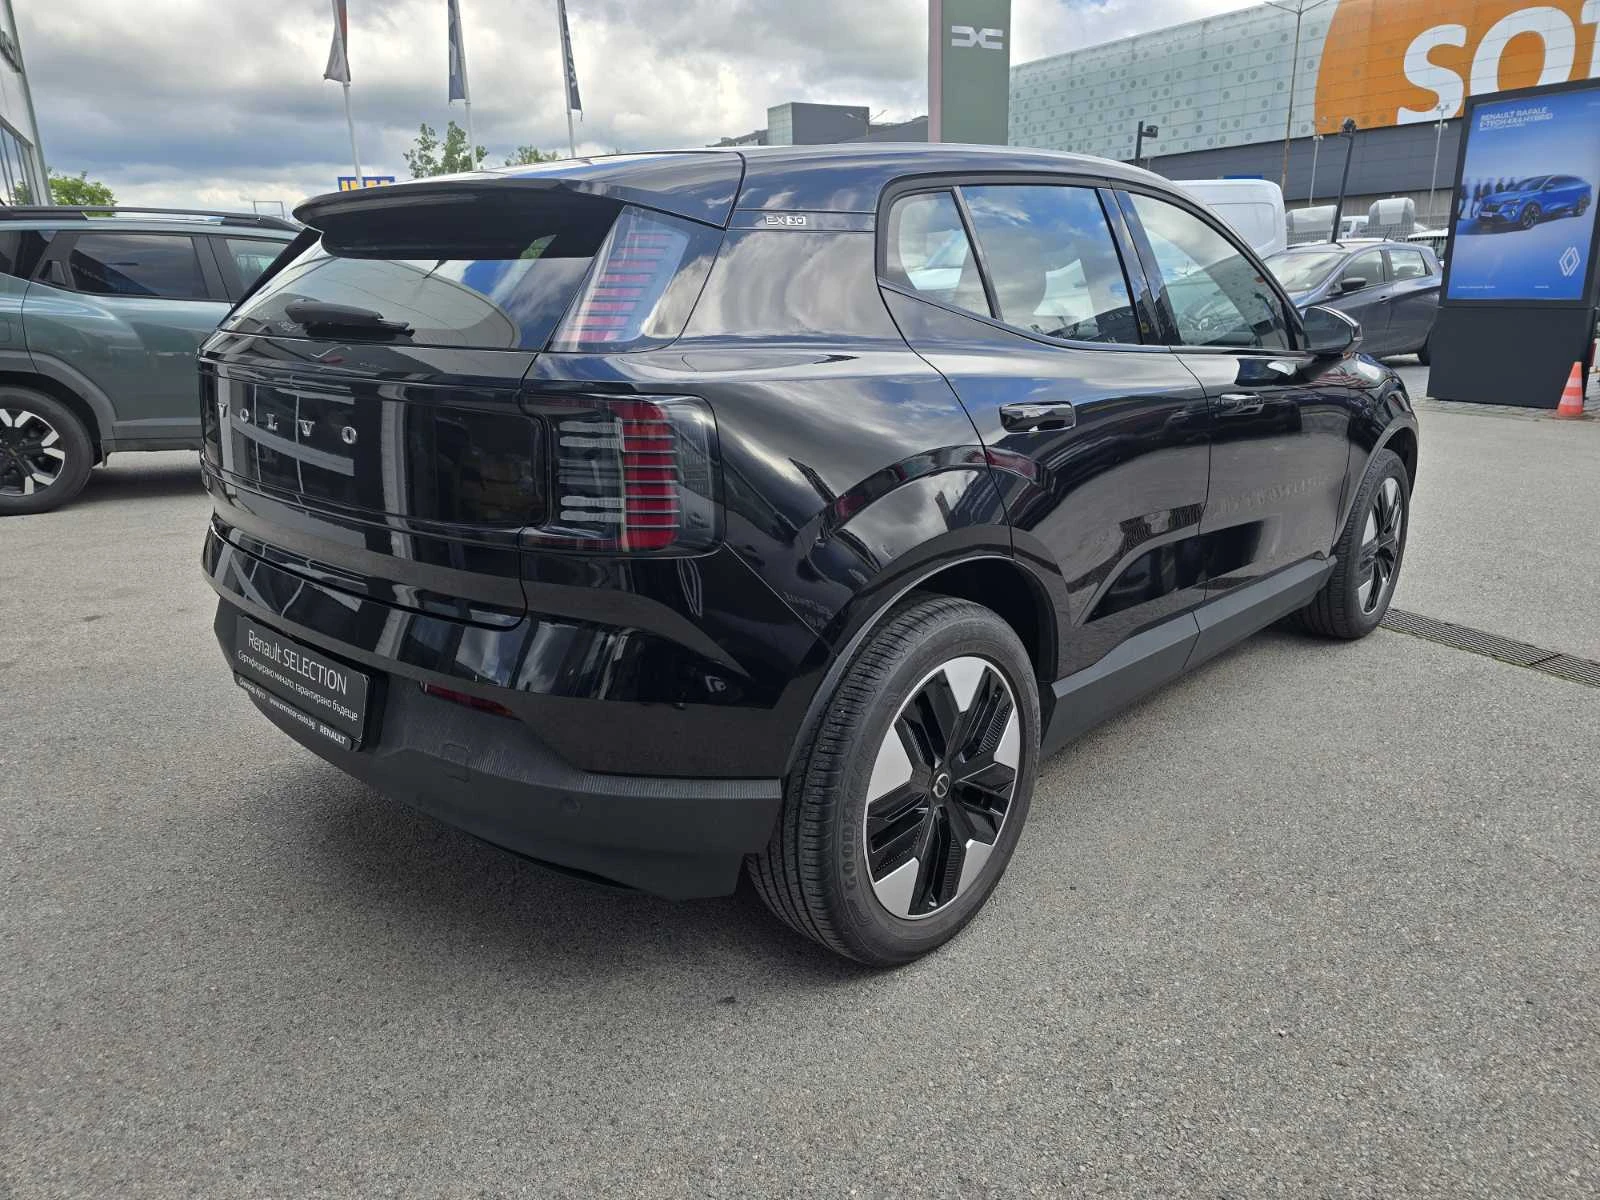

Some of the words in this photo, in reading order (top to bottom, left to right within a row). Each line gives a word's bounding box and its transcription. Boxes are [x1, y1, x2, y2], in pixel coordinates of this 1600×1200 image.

[217, 402, 357, 445] VOLVO
[248, 630, 281, 664] Renault
[283, 648, 347, 695] SELECTION
[332, 699, 358, 722] бъдеще
[319, 724, 347, 745] RENAULT
